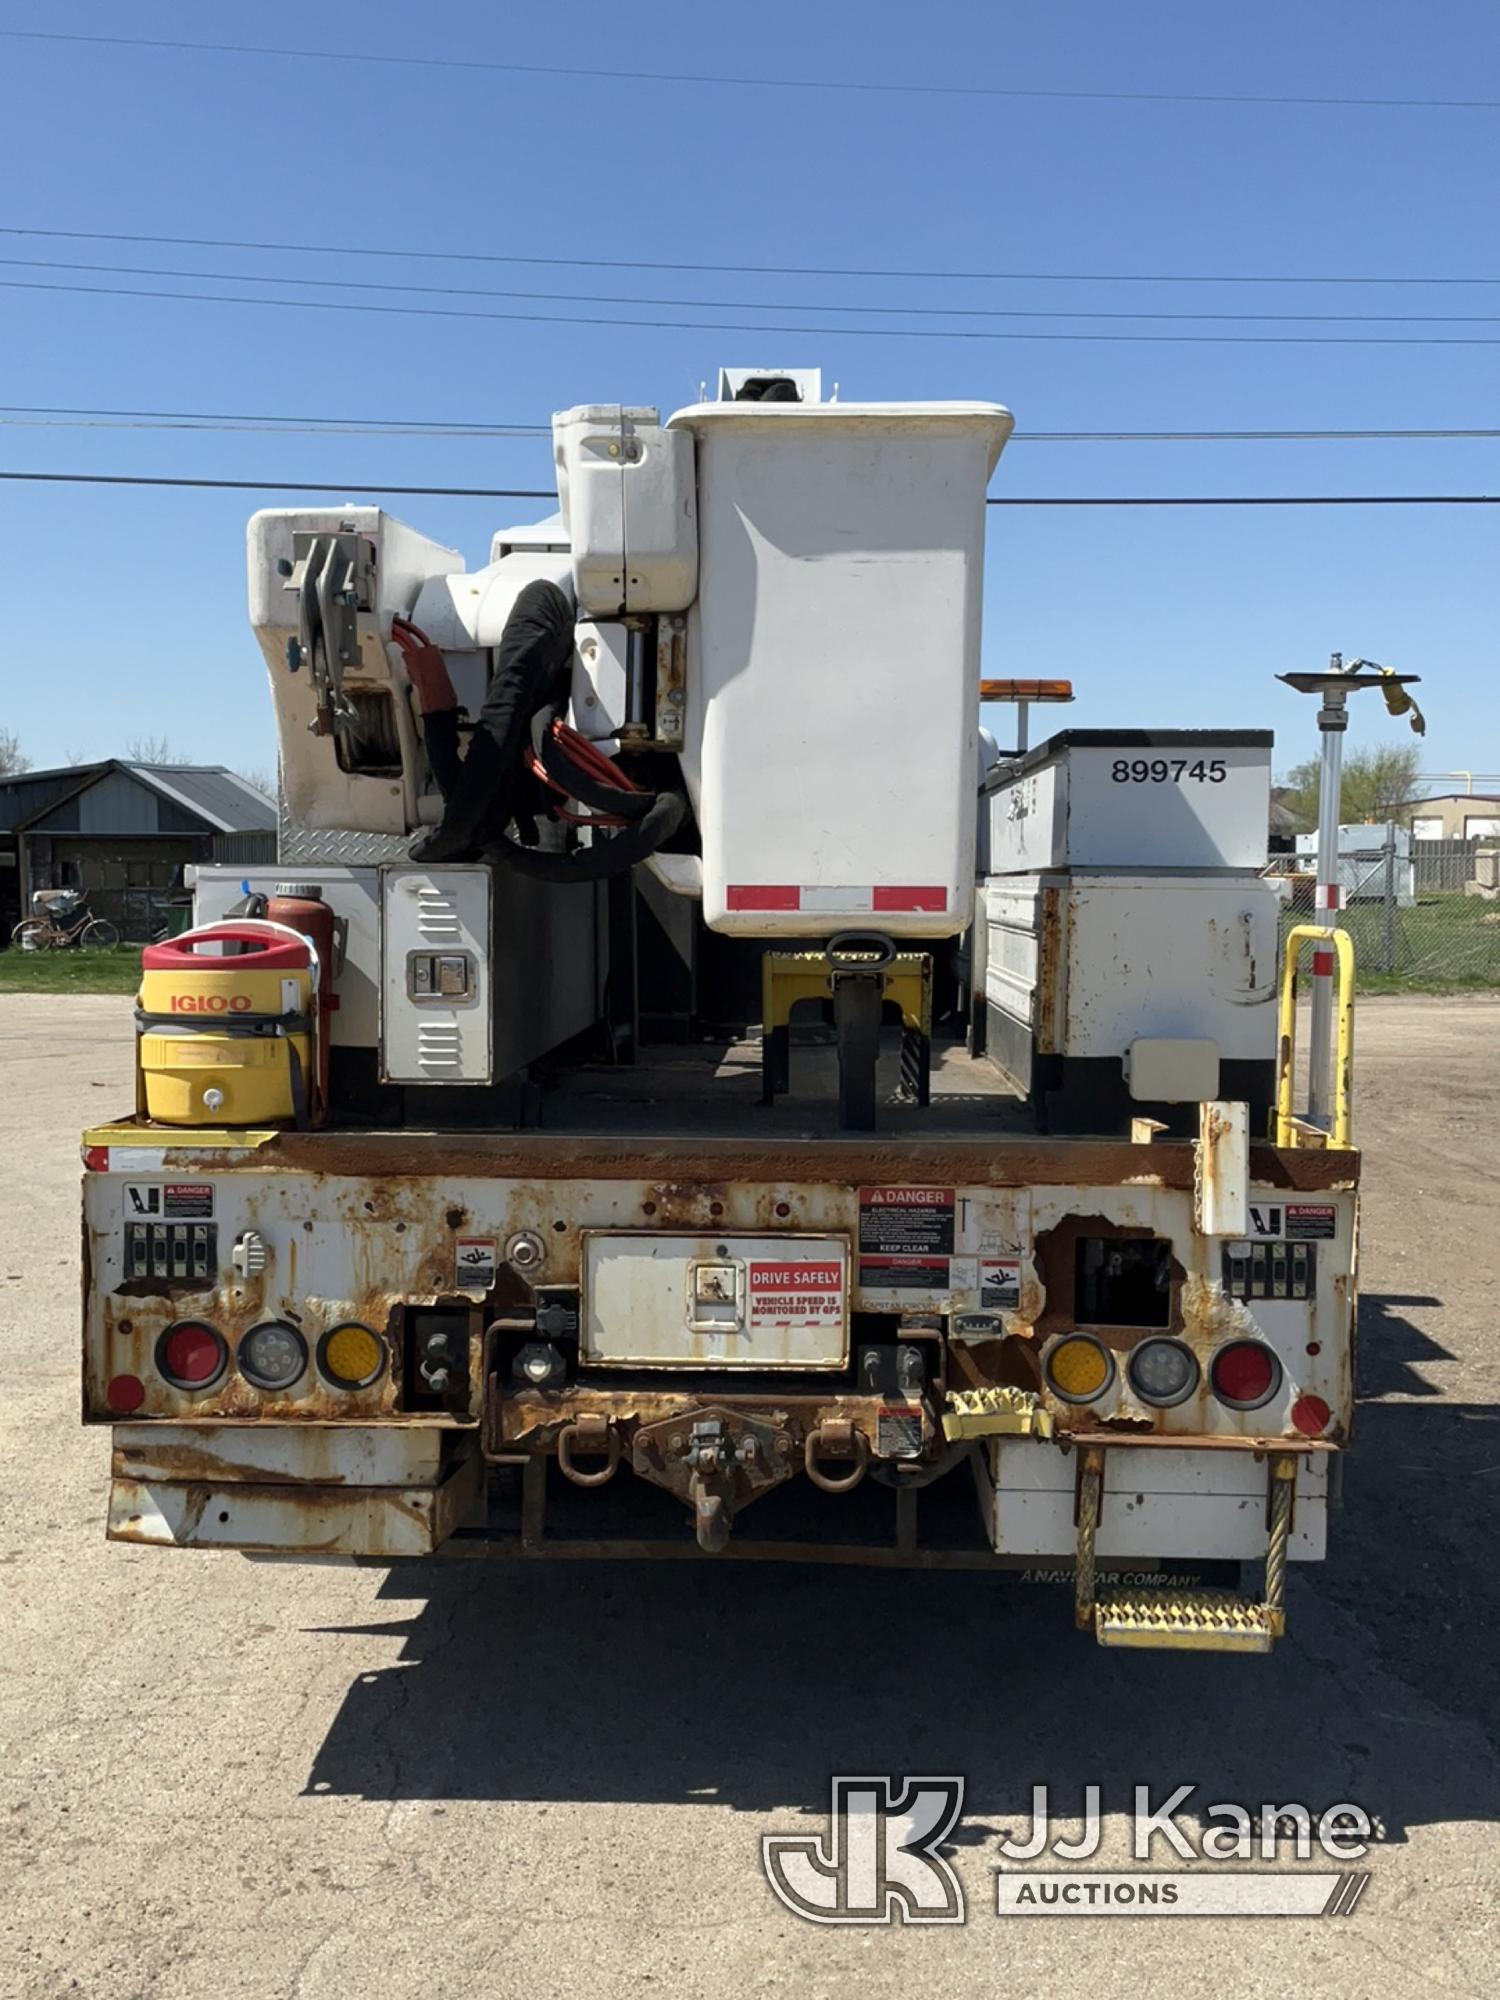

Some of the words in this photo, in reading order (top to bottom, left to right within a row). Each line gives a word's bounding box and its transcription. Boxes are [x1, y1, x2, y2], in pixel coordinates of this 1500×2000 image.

[1111, 759, 1227, 783] 899745
[171, 995, 252, 1012] IGLOO
[177, 1186, 210, 1194] DANGER
[886, 1190, 945, 1204] DANGER
[1299, 1207, 1333, 1215] DANGER
[902, 1244, 929, 1252] CLEAR
[752, 1271, 790, 1284] DRIVE
[793, 1271, 839, 1284] SAFELY
[755, 1296, 794, 1305] VEHICLE
[796, 1296, 826, 1305] SPEED
[827, 1296, 836, 1305] IS
[752, 1306, 807, 1315] MONITORED
[809, 1306, 821, 1315] BY
[822, 1305, 841, 1315] GPS
[1021, 1569, 1031, 1581] A
[1122, 1572, 1201, 1587] COMPANY
